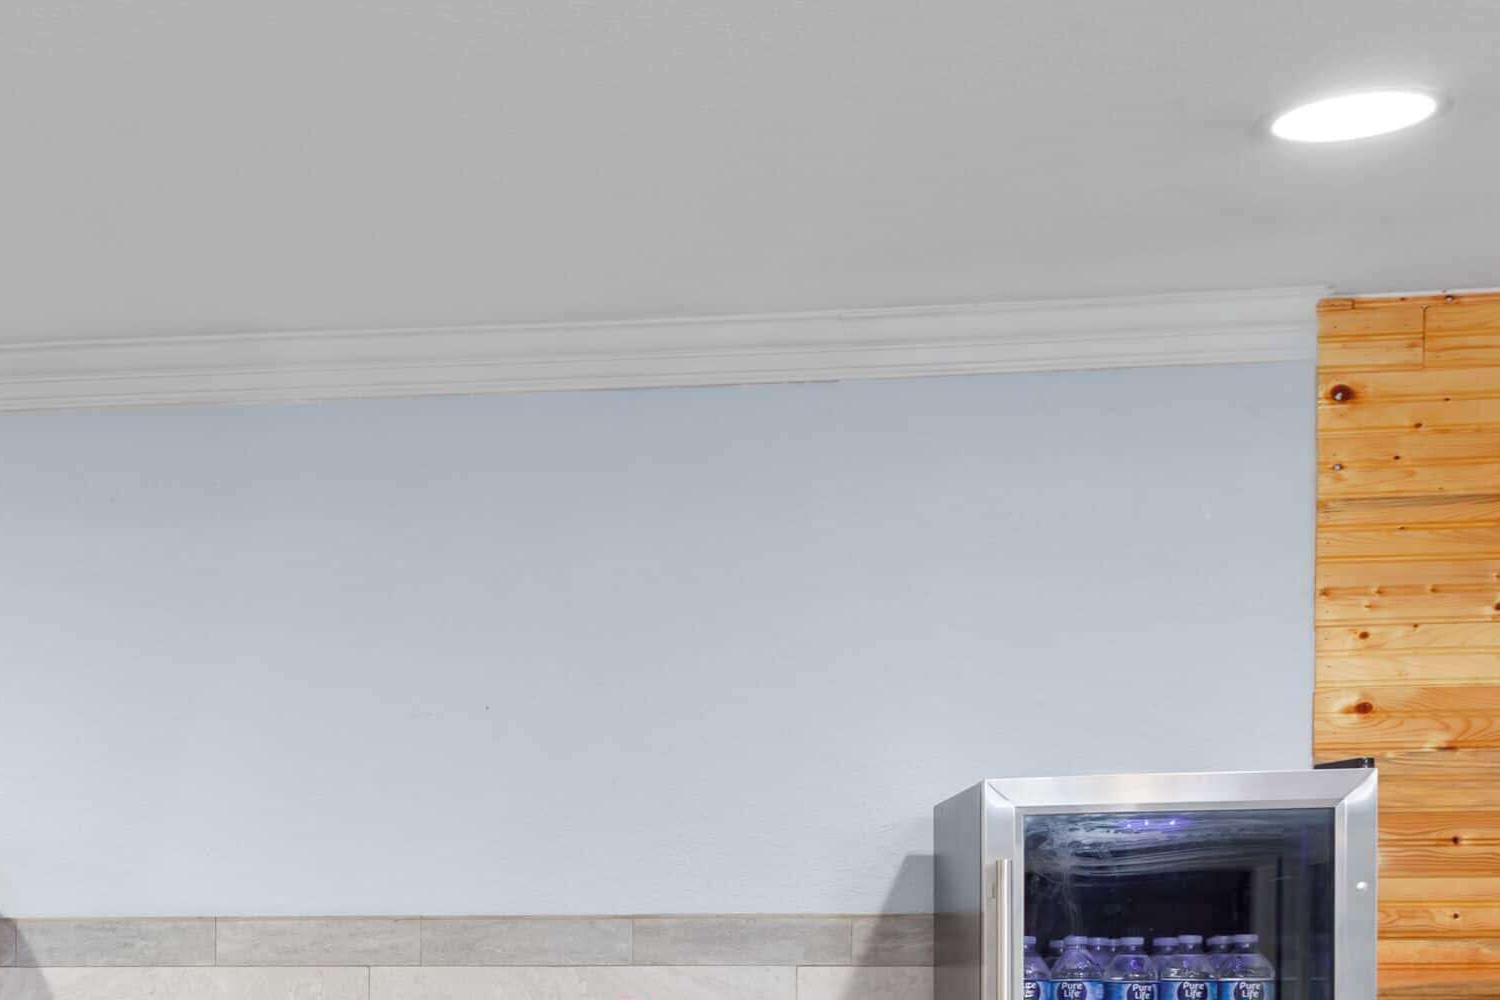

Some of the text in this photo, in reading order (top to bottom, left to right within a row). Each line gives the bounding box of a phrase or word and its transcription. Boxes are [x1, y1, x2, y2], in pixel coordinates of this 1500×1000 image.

[1062, 982, 1082, 990] Pure
[1132, 984, 1152, 992] Pure
[1182, 982, 1204, 990] Pure
[1240, 982, 1260, 990] Pure
[1064, 989, 1080, 999] Life
[1135, 991, 1150, 1000] Life
[1185, 989, 1202, 1000] Life
[1242, 989, 1259, 1000] Life
